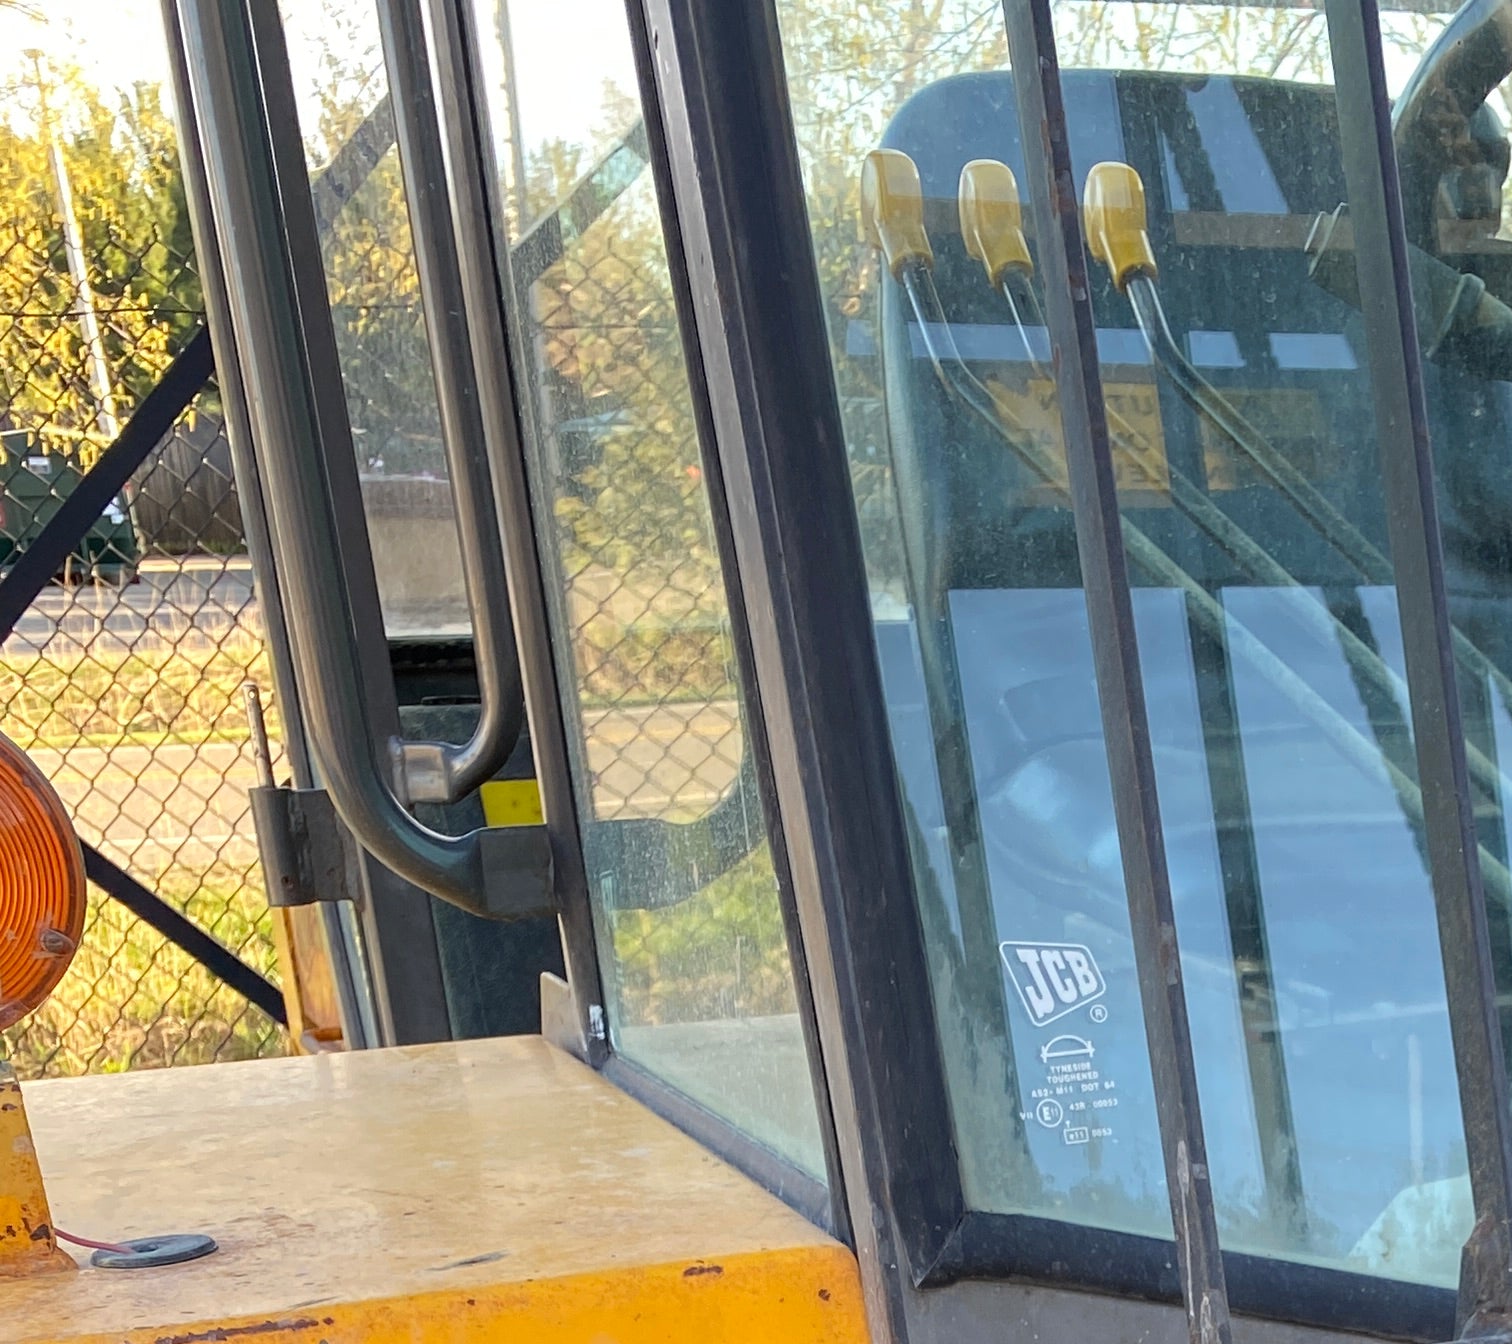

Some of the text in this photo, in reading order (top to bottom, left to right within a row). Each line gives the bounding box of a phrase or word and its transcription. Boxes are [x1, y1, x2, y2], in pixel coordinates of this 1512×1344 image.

[1016, 948, 1099, 1019] JCB
[1049, 1062, 1092, 1074] TYNESIDE
[1046, 1071, 1100, 1084] TOUGHENED
[1080, 1082, 1100, 1092] DOT
